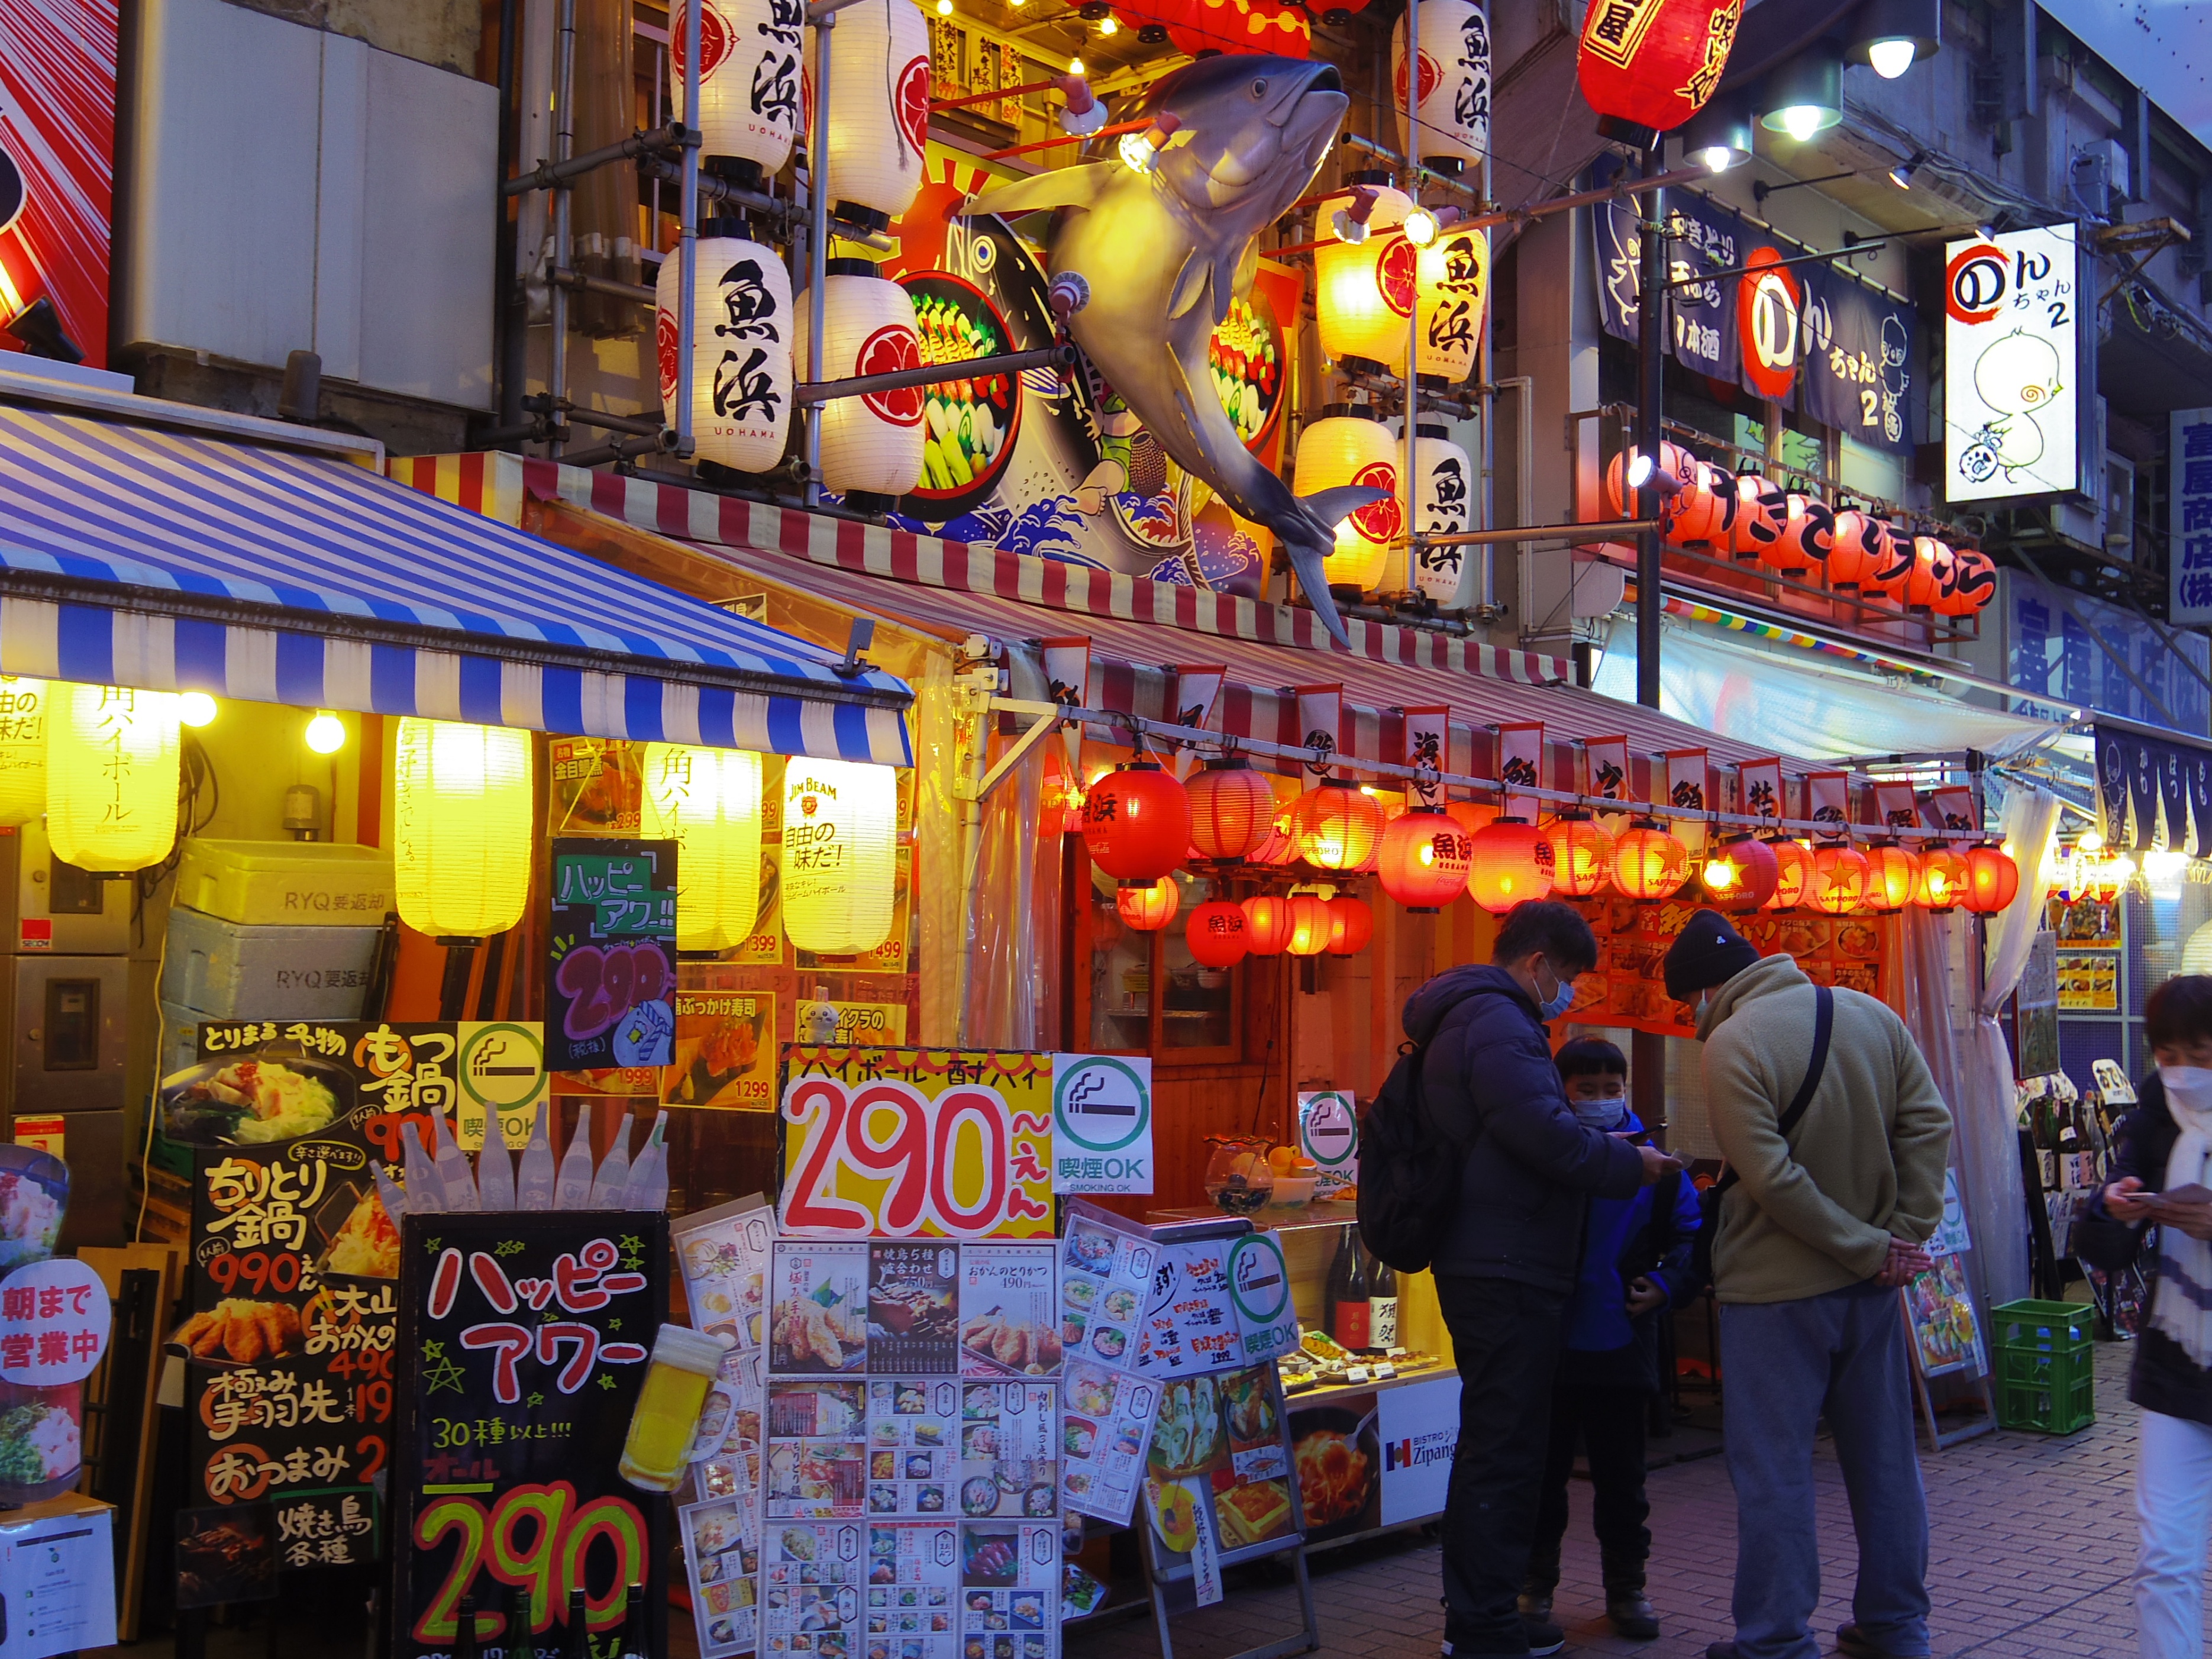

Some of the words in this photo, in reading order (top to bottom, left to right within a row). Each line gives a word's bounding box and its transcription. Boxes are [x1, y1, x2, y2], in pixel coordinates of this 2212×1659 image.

[1455, 15, 1490, 133] 魚浜
[1428, 237, 1480, 355] 魚浜
[1954, 250, 2051, 311] のん
[2013, 279, 2071, 310] ちゃん
[1751, 273, 1832, 368] のん
[2046, 301, 2070, 328] 2
[713, 259, 781, 422] 魚浜
[1426, 354, 1468, 367] UOHAMA
[1829, 346, 1877, 383] ちゃん
[1861, 389, 1879, 426] 2
[715, 427, 776, 439] UOHAMA
[1420, 457, 1467, 575] 魚浜
[789, 783, 804, 802] JIM
[806, 776, 837, 801] BEAM
[786, 822, 835, 848] 自由の
[794, 844, 842, 871] 味だ!
[561, 861, 644, 900] ハッピー
[600, 898, 674, 929] アワー!!
[1820, 895, 1858, 903] SAPPORO
[1207, 915, 1243, 933] 魚浜
[745, 935, 777, 952] 1399
[868, 940, 901, 959] 1499
[556, 945, 670, 1041] 290
[837, 1008, 885, 1031] イクラの
[205, 1022, 277, 1051] とりまる
[285, 1023, 347, 1056] 名物
[364, 1024, 456, 1072] もつ
[360, 1063, 456, 1113] 鍋
[618, 1068, 653, 1085] 1999
[734, 1080, 770, 1099] 1299
[801, 1057, 1036, 1090] ハイボール・酎ハイ
[782, 1073, 1010, 1237] 290
[1058, 1158, 1144, 1181] 喫煙OK
[205, 1158, 327, 1208] ちりとり
[1070, 1184, 1115, 1193] SMOKING
[1116, 1184, 1131, 1193] OK
[206, 1201, 306, 1250] 鍋
[883, 1248, 935, 1261] 焼鳥5種
[208, 1252, 301, 1294] 990
[298, 1254, 317, 1292] えん
[427, 1238, 648, 1320] ハッピー
[968, 1266, 1048, 1277] おかんのとりかつ
[1000, 1277, 1031, 1289] 490円
[2, 1283, 92, 1322] 朝まで
[334, 1284, 397, 1315] 大山
[1, 1328, 99, 1370] 営業中
[305, 1318, 396, 1355] おかんの
[1245, 1323, 1298, 1355] 喫煙OK
[459, 1322, 648, 1405] アワー
[208, 1368, 297, 1399] 極み
[208, 1379, 345, 1441] 手羽先
[432, 1416, 573, 1448] 30種以上!!!
[1413, 1432, 1444, 1447] BISTRO
[209, 1445, 350, 1496] おつまみ
[422, 1452, 501, 1482] オール
[1413, 1443, 1458, 1467] Zipang
[277, 1495, 373, 1542] 焼き鳥
[285, 1535, 355, 1567] 各種
[412, 1480, 650, 1645] 290
